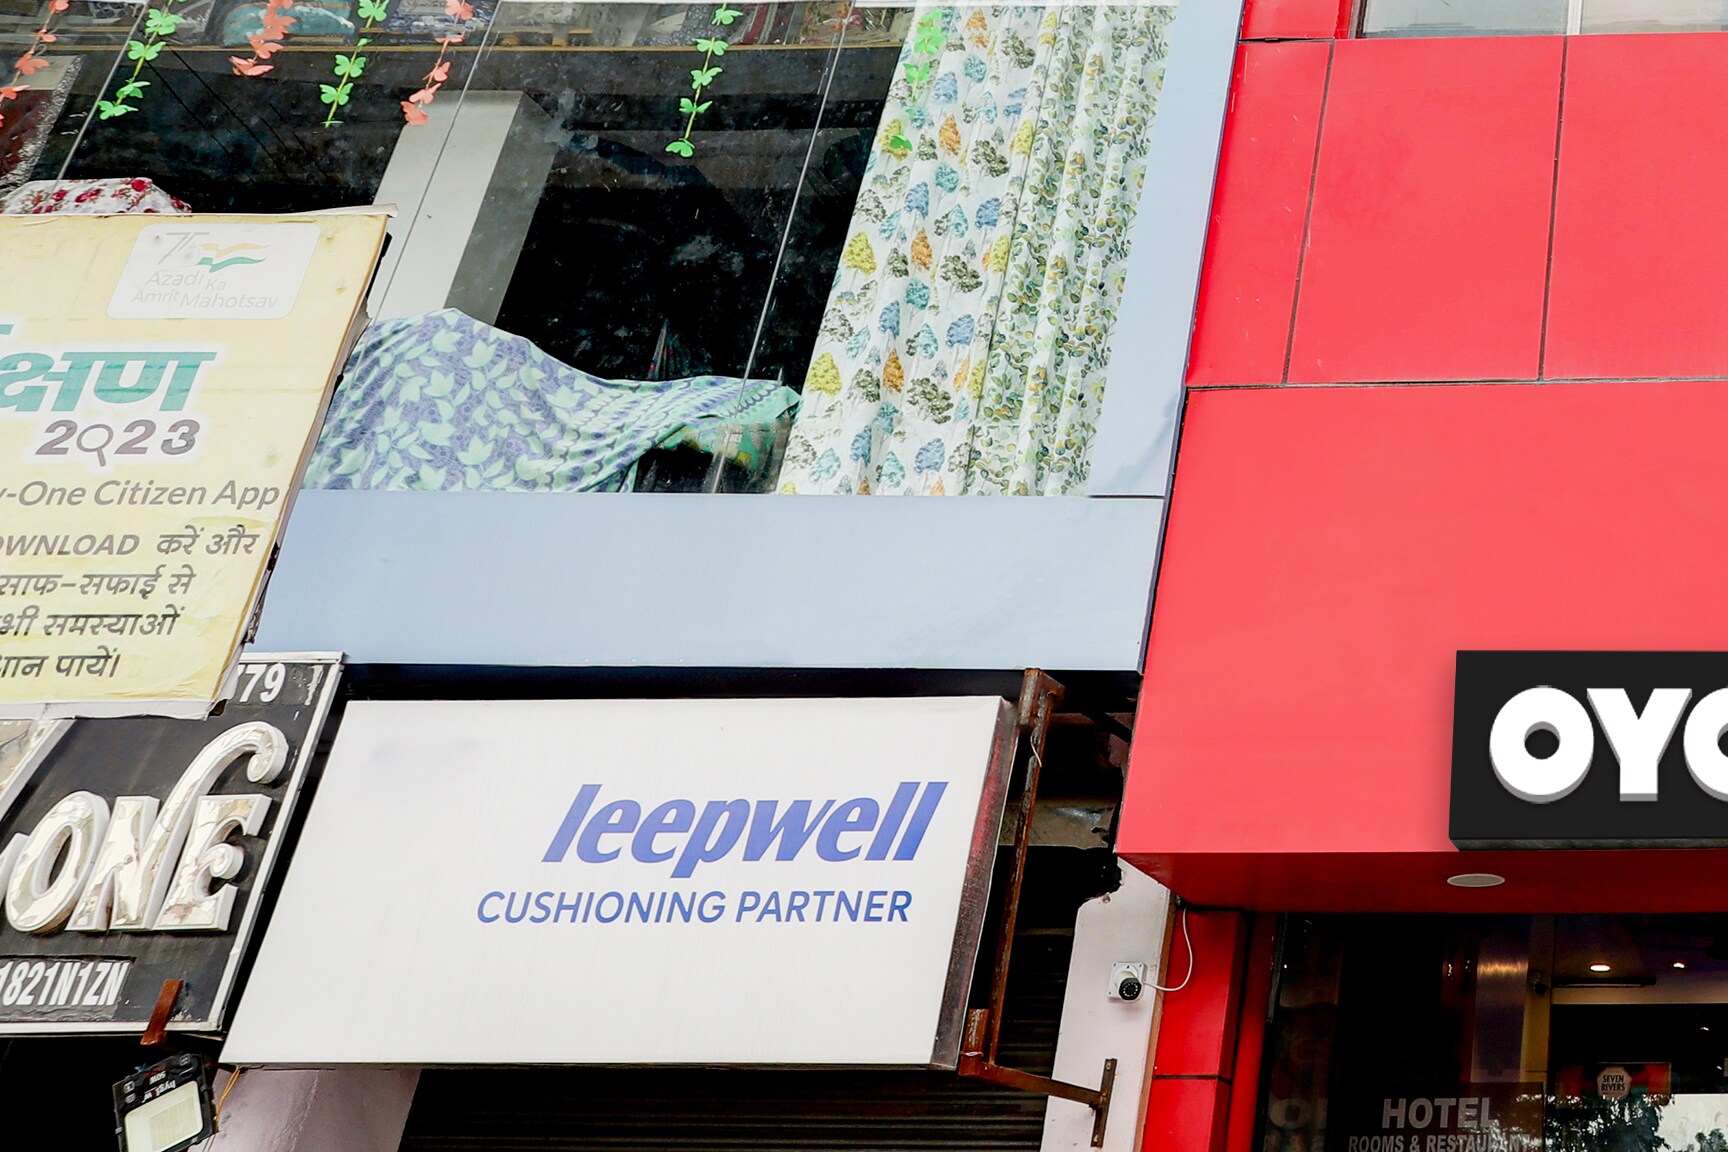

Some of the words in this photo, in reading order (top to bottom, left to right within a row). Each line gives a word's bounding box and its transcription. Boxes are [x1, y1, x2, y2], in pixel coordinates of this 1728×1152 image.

[145, 270, 206, 287] Azadi
[205, 278, 227, 291] Ka
[131, 288, 180, 303] Amrit
[179, 293, 280, 309] Mahotsav
[94, 479, 207, 506] Citizen
[212, 480, 280, 510] App
[156, 524, 204, 555] करें
[205, 524, 260, 555] और
[167, 564, 196, 595] से
[43, 604, 185, 636] समस्याओं
[0, 721, 289, 934] ONE
[541, 781, 950, 879] leepwell
[476, 890, 727, 924] CUSHIONING
[735, 889, 912, 923] PARTNER
[1602, 1074, 1625, 1083] SEVEN
[1381, 1097, 1494, 1129] HOTEL
